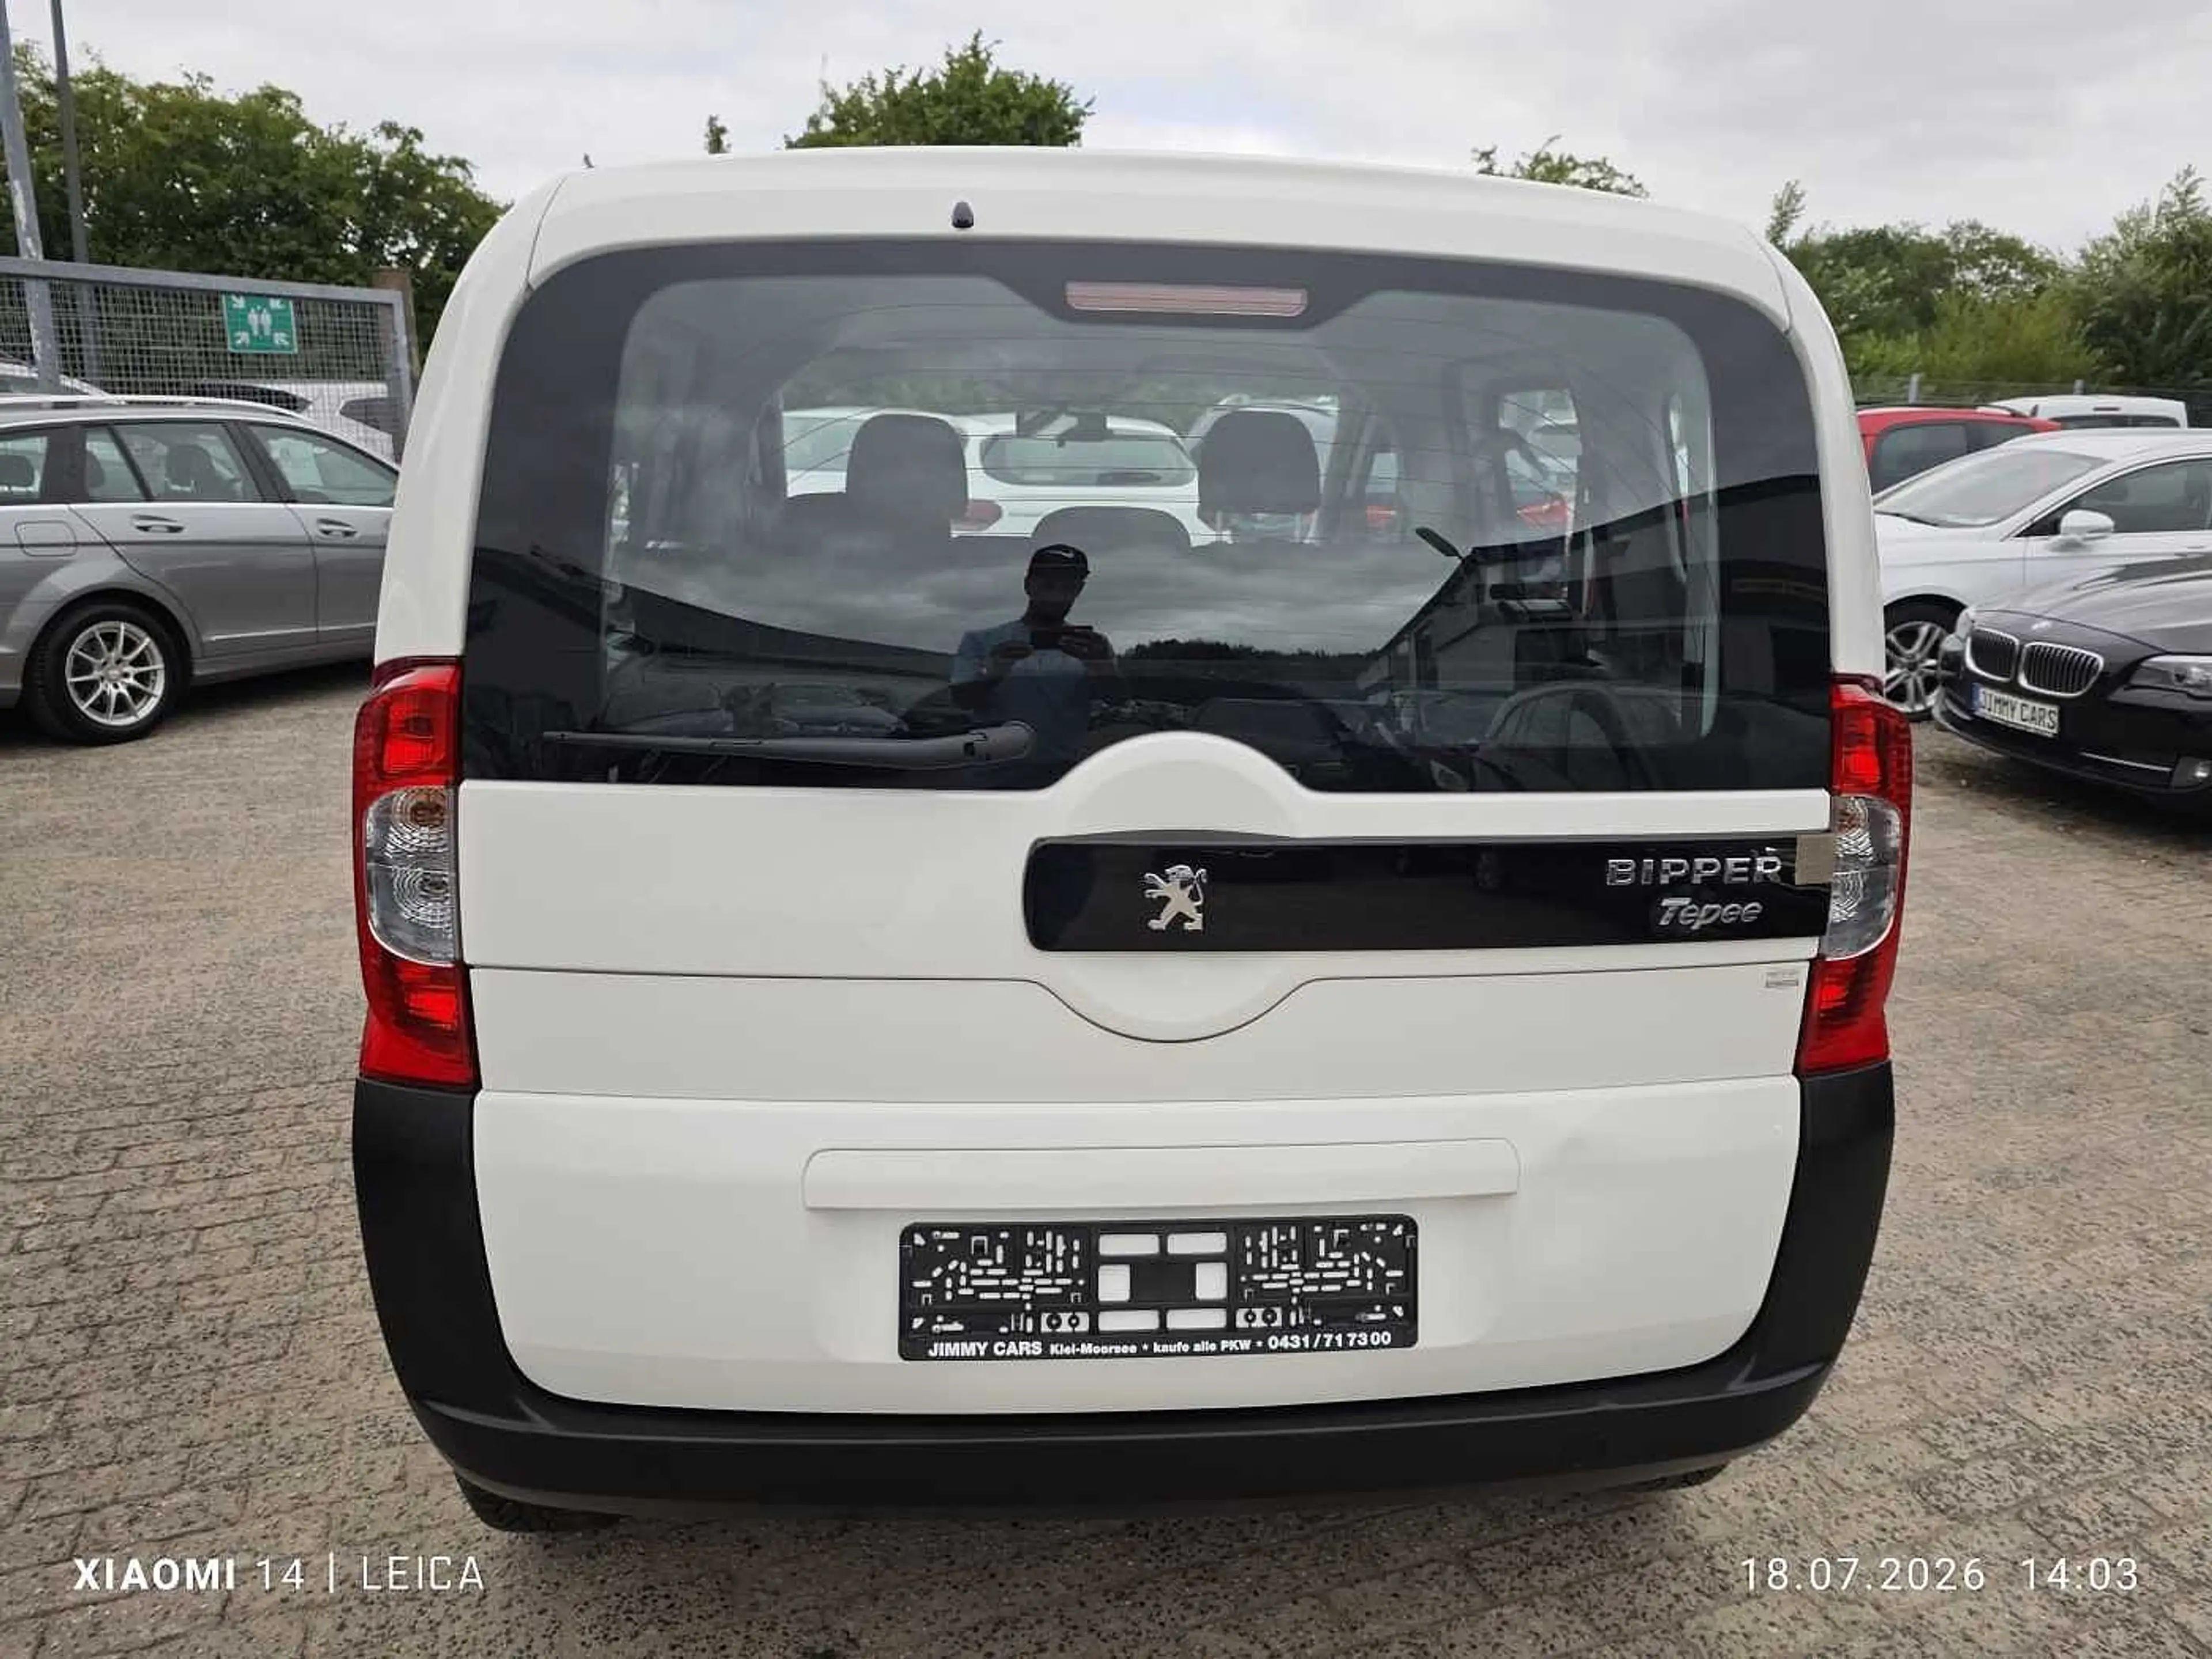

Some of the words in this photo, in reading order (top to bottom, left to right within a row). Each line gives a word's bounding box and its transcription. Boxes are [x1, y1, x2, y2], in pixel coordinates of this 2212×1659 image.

[1983, 690, 2017, 720] JIMMY
[2020, 703, 2056, 730] CARS
[1606, 856, 1782, 886] BIPPER
[1658, 897, 1764, 930] Tepee
[928, 1342, 988, 1357] JIMMY
[993, 1340, 1043, 1356] CARS
[1153, 1341, 1190, 1354] kaufe
[1192, 1340, 1217, 1352] alle
[1220, 1339, 1252, 1351] PKW
